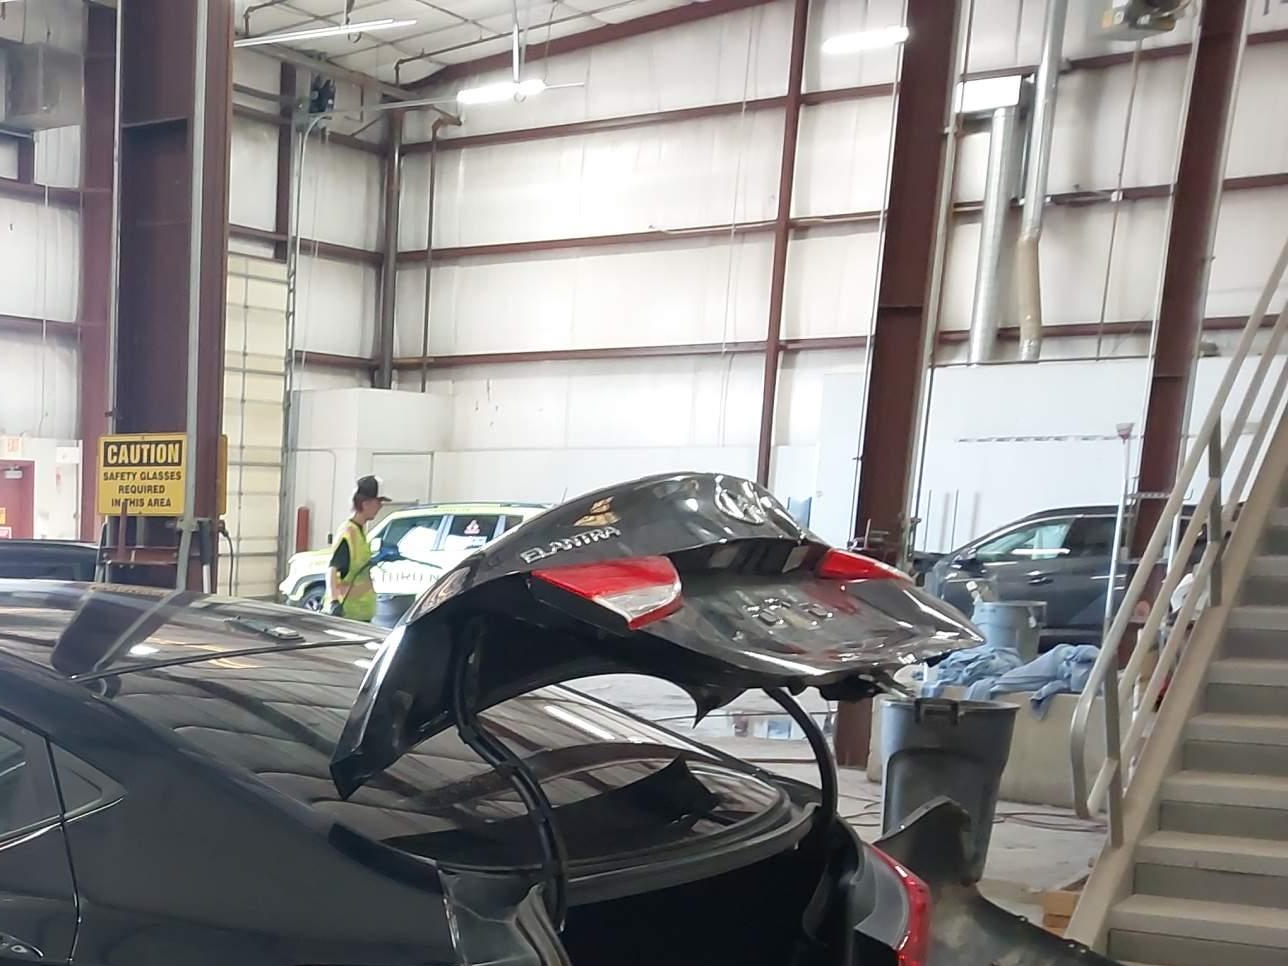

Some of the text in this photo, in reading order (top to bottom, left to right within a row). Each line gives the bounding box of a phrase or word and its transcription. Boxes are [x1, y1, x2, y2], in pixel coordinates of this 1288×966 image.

[107, 444, 179, 464] CAUTION
[103, 471, 181, 481] SAFETY GLASSES
[118, 485, 166, 494] REQUIRED
[111, 498, 171, 507] IN THIS AREA
[519, 525, 620, 562] ELANTRA
